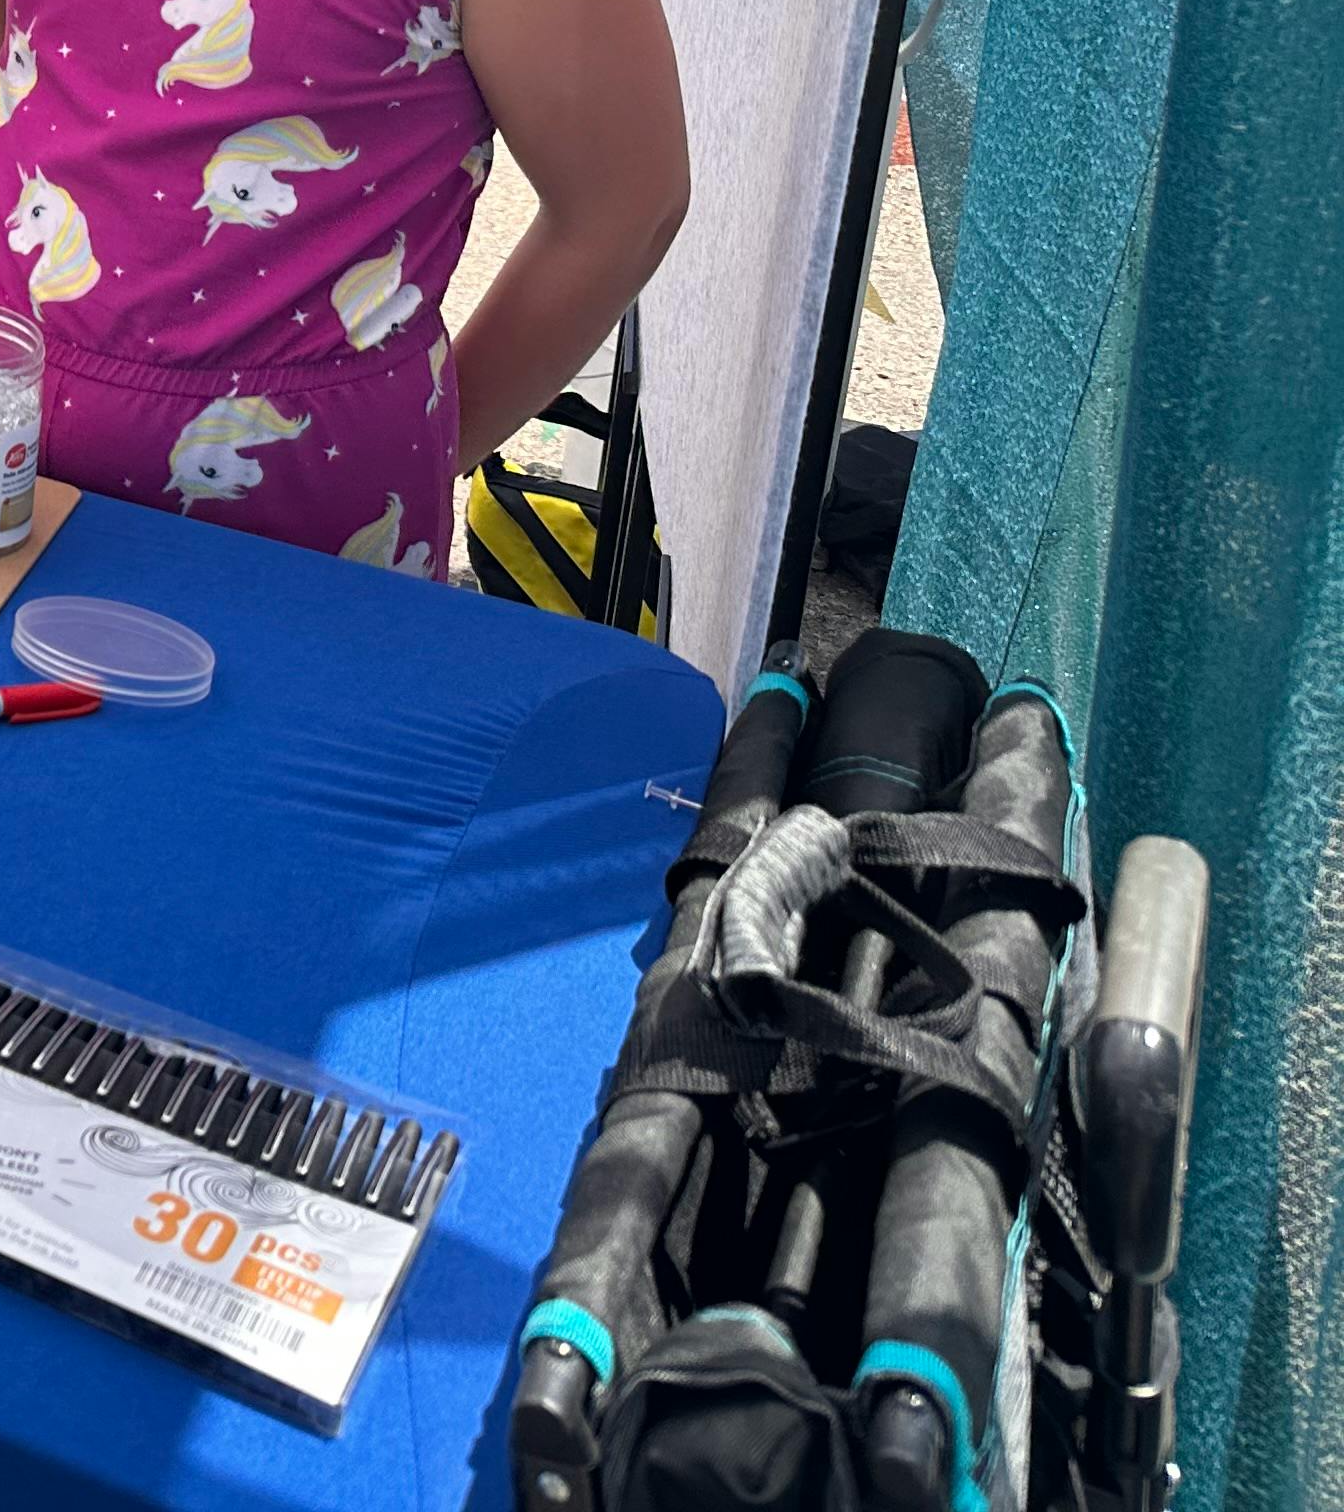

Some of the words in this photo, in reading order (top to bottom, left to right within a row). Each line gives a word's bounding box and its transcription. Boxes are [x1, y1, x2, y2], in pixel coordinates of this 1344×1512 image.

[132, 1191, 240, 1264] 30
[250, 1232, 323, 1273] pcs
[144, 1296, 190, 1325] MADE
[191, 1315, 212, 1334] IN
[212, 1326, 259, 1357] CHINA
